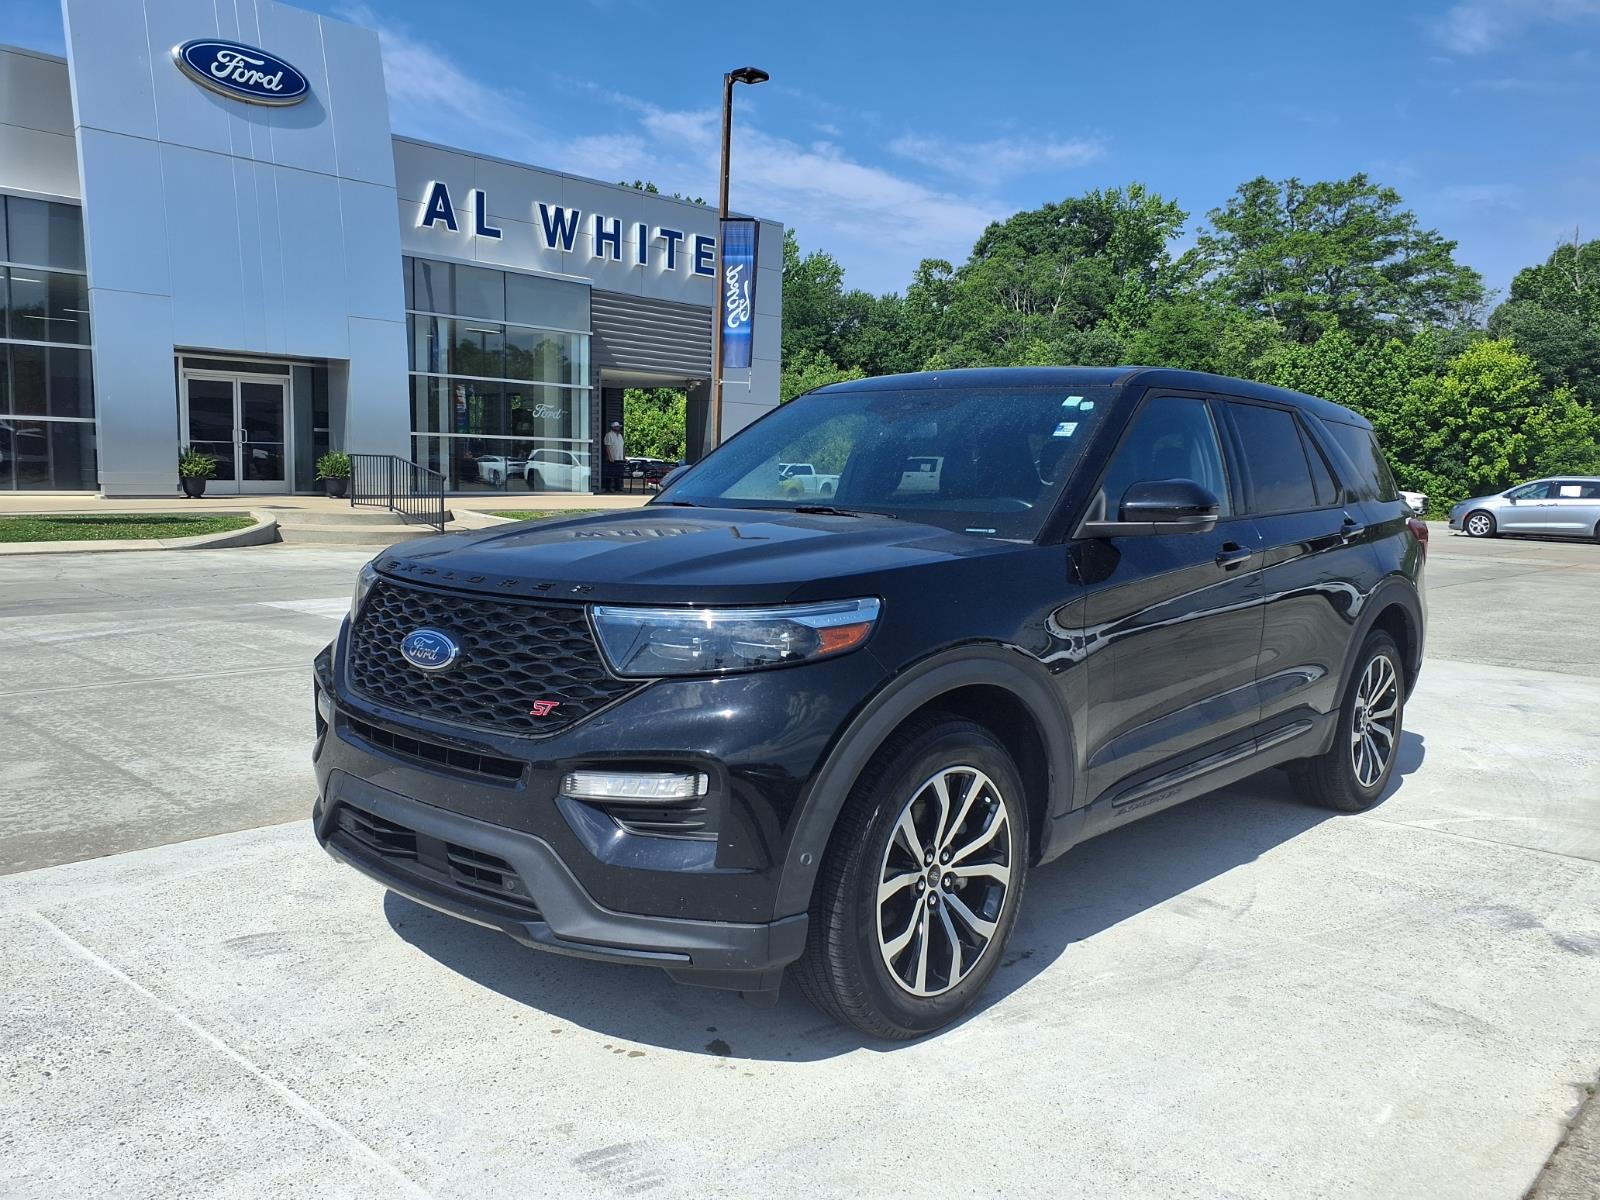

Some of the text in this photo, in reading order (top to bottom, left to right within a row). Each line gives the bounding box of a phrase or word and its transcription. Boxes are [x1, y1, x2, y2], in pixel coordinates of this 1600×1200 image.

[211, 51, 283, 91] Ford
[417, 180, 716, 278] AL WHITE
[532, 403, 562, 419] Ford
[409, 636, 441, 661] Ford
[529, 700, 560, 716] ST
